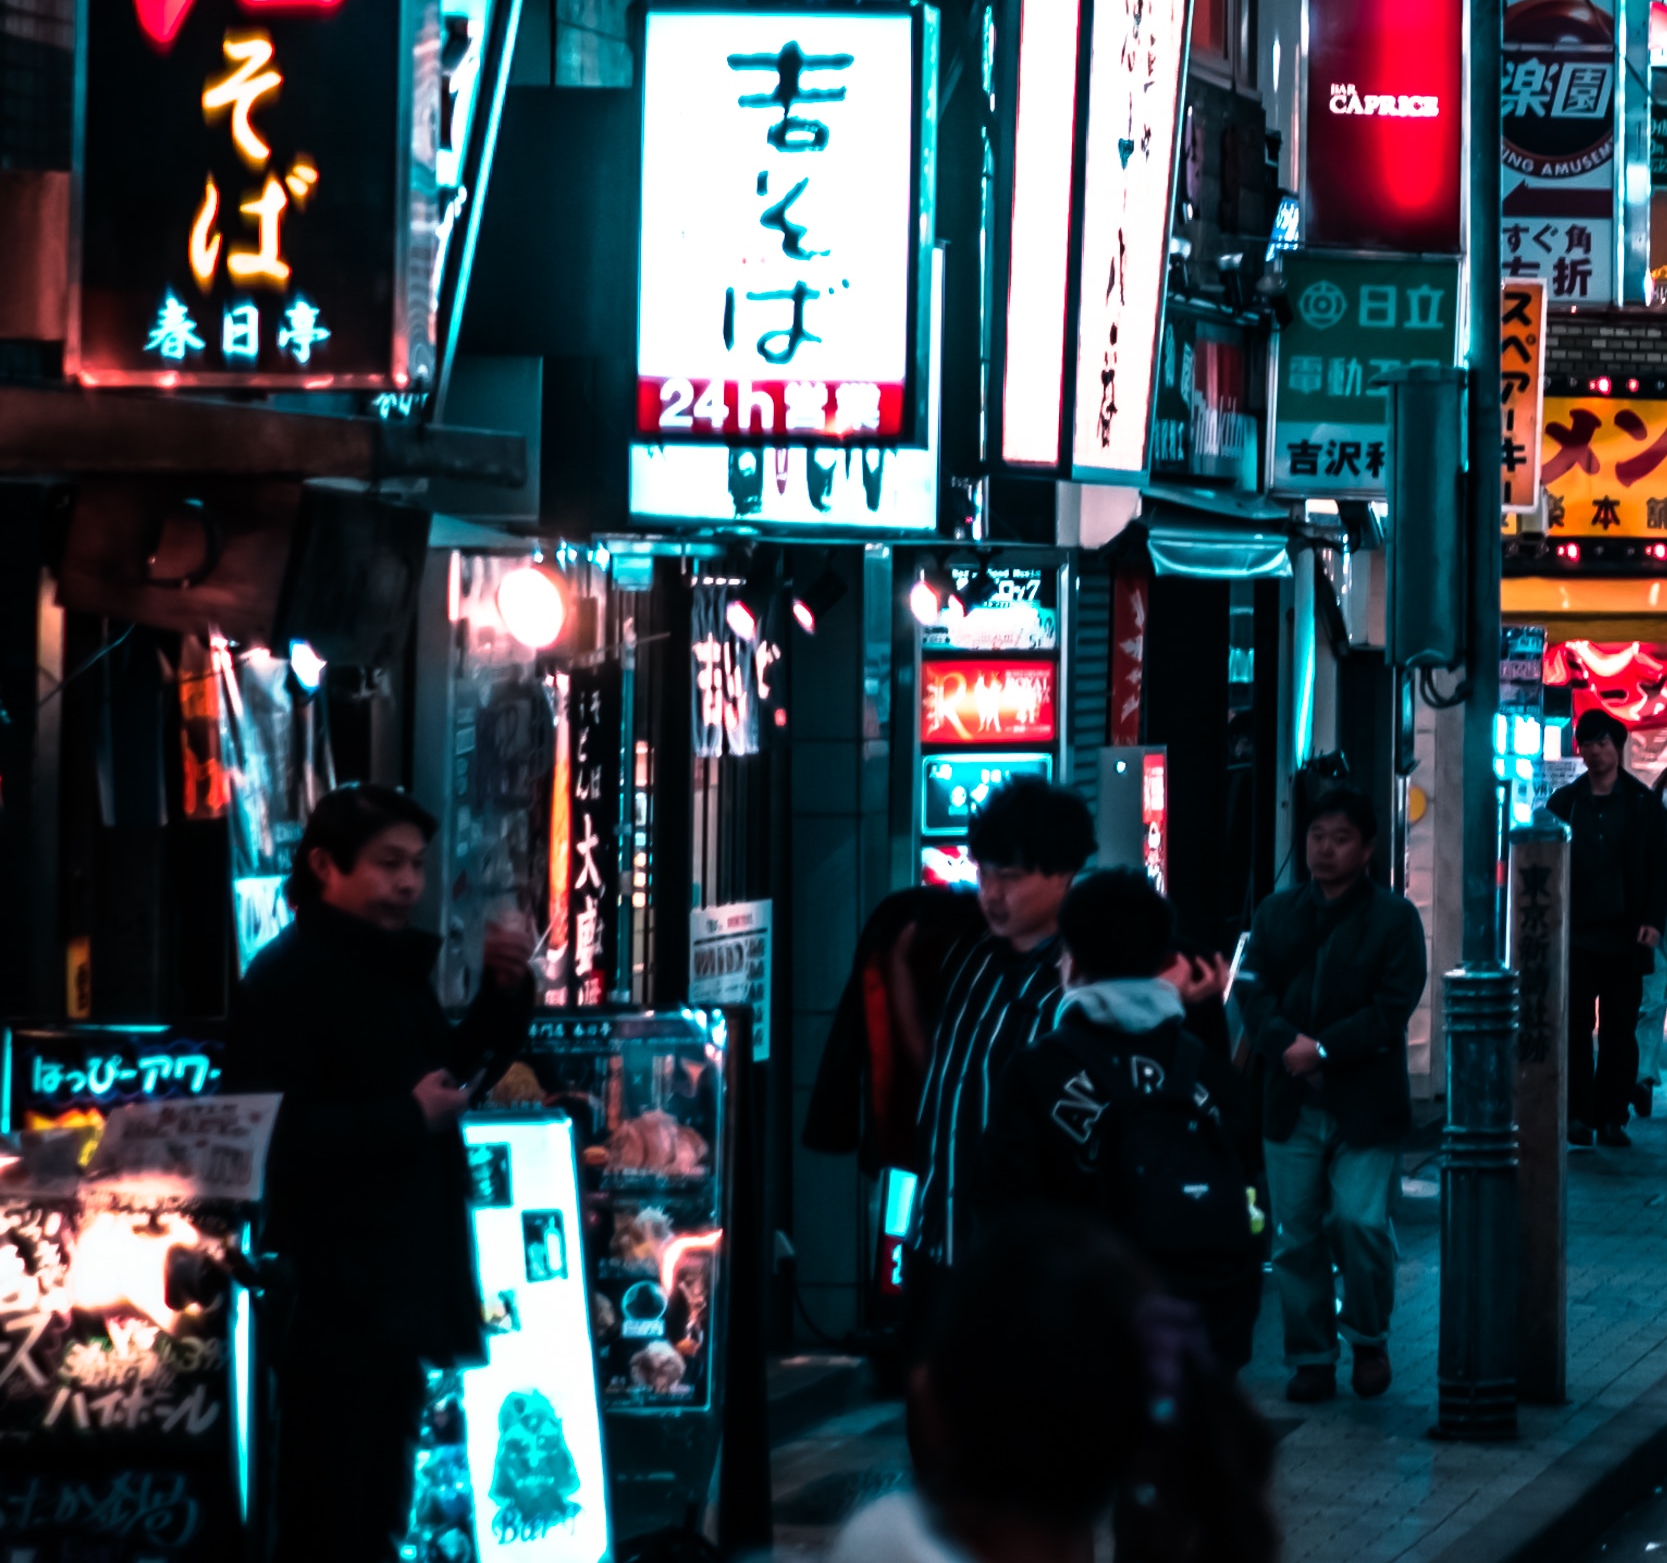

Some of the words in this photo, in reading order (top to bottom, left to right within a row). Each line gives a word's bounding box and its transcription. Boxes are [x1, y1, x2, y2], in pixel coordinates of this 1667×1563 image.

[1329, 94, 1440, 119] CAPRICE
[1501, 57, 1613, 119] 楽園
[1502, 222, 1592, 255] すぐ角
[143, 294, 332, 362] 春日亭
[1358, 284, 1445, 329] 日立
[1288, 356, 1441, 398] 電動工
[1502, 291, 1538, 505] スペアーキー
[659, 379, 882, 432] 24h営業
